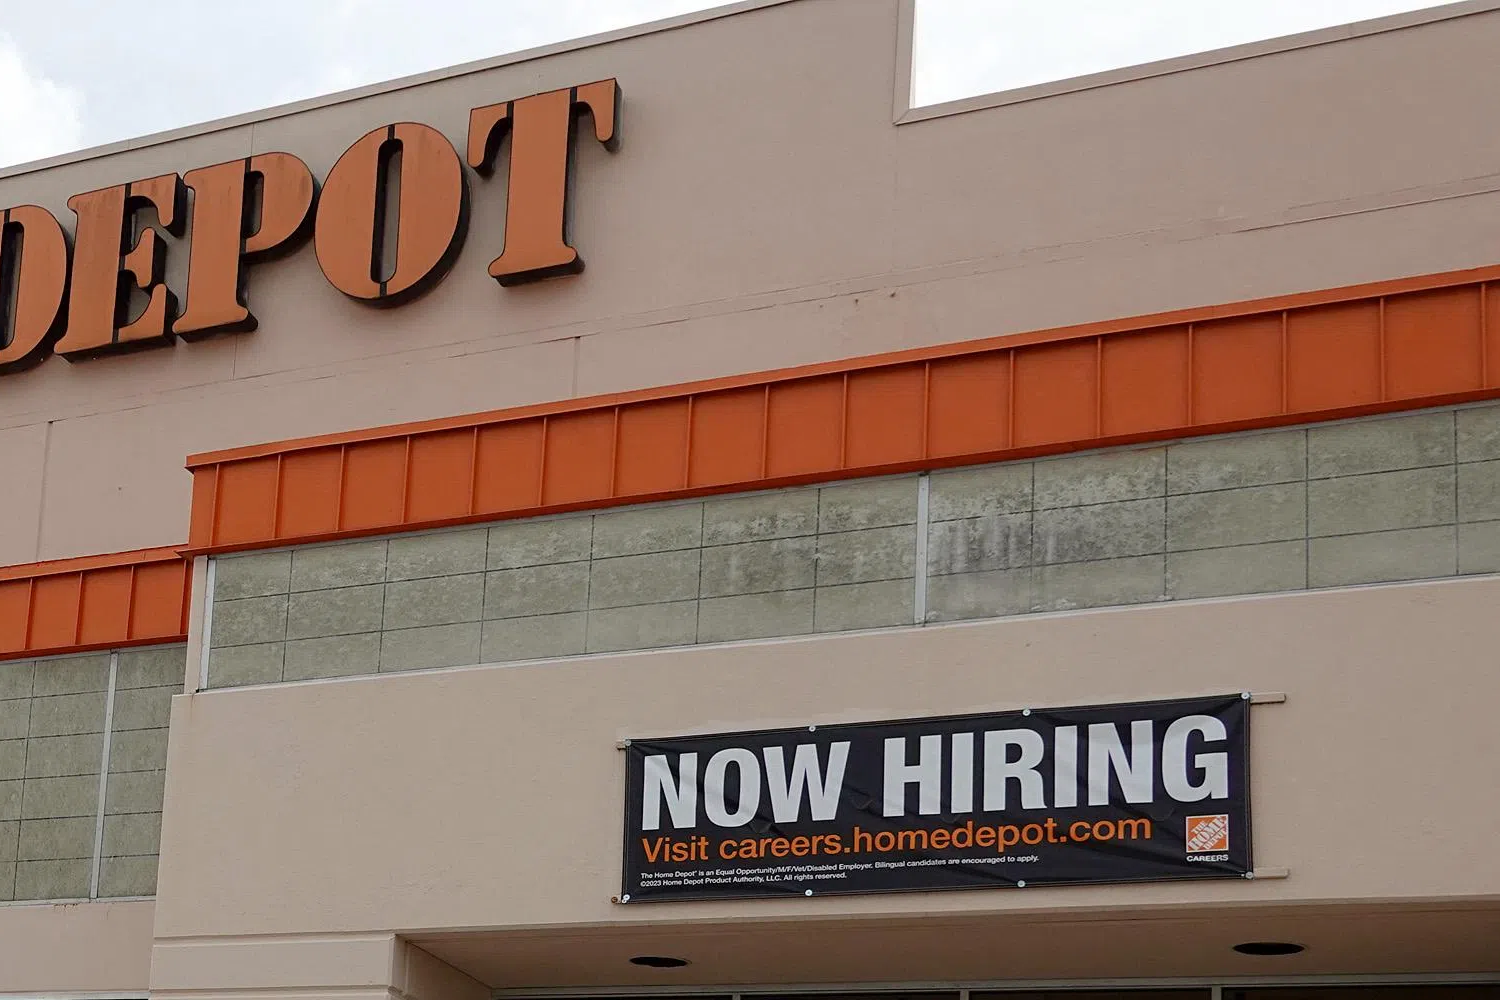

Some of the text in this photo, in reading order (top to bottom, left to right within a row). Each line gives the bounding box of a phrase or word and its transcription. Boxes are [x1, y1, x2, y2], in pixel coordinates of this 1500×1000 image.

[642, 715, 1228, 831] NOW HIRING
[642, 815, 1151, 863] Visit careers.homedepot.com
[1187, 815, 1226, 850] HOME
[654, 870, 674, 879] Home
[716, 867, 735, 877] Equal
[875, 860, 906, 870] Bilingual
[906, 858, 947, 868] candidates
[961, 856, 1006, 866] encouraged
[1007, 855, 1016, 863] to
[1017, 854, 1040, 864] apply.
[1186, 854, 1229, 862] CAREERS
[640, 872, 847, 888] ©2023 Home Depot Product Authority, LLC. All rights reserved.
